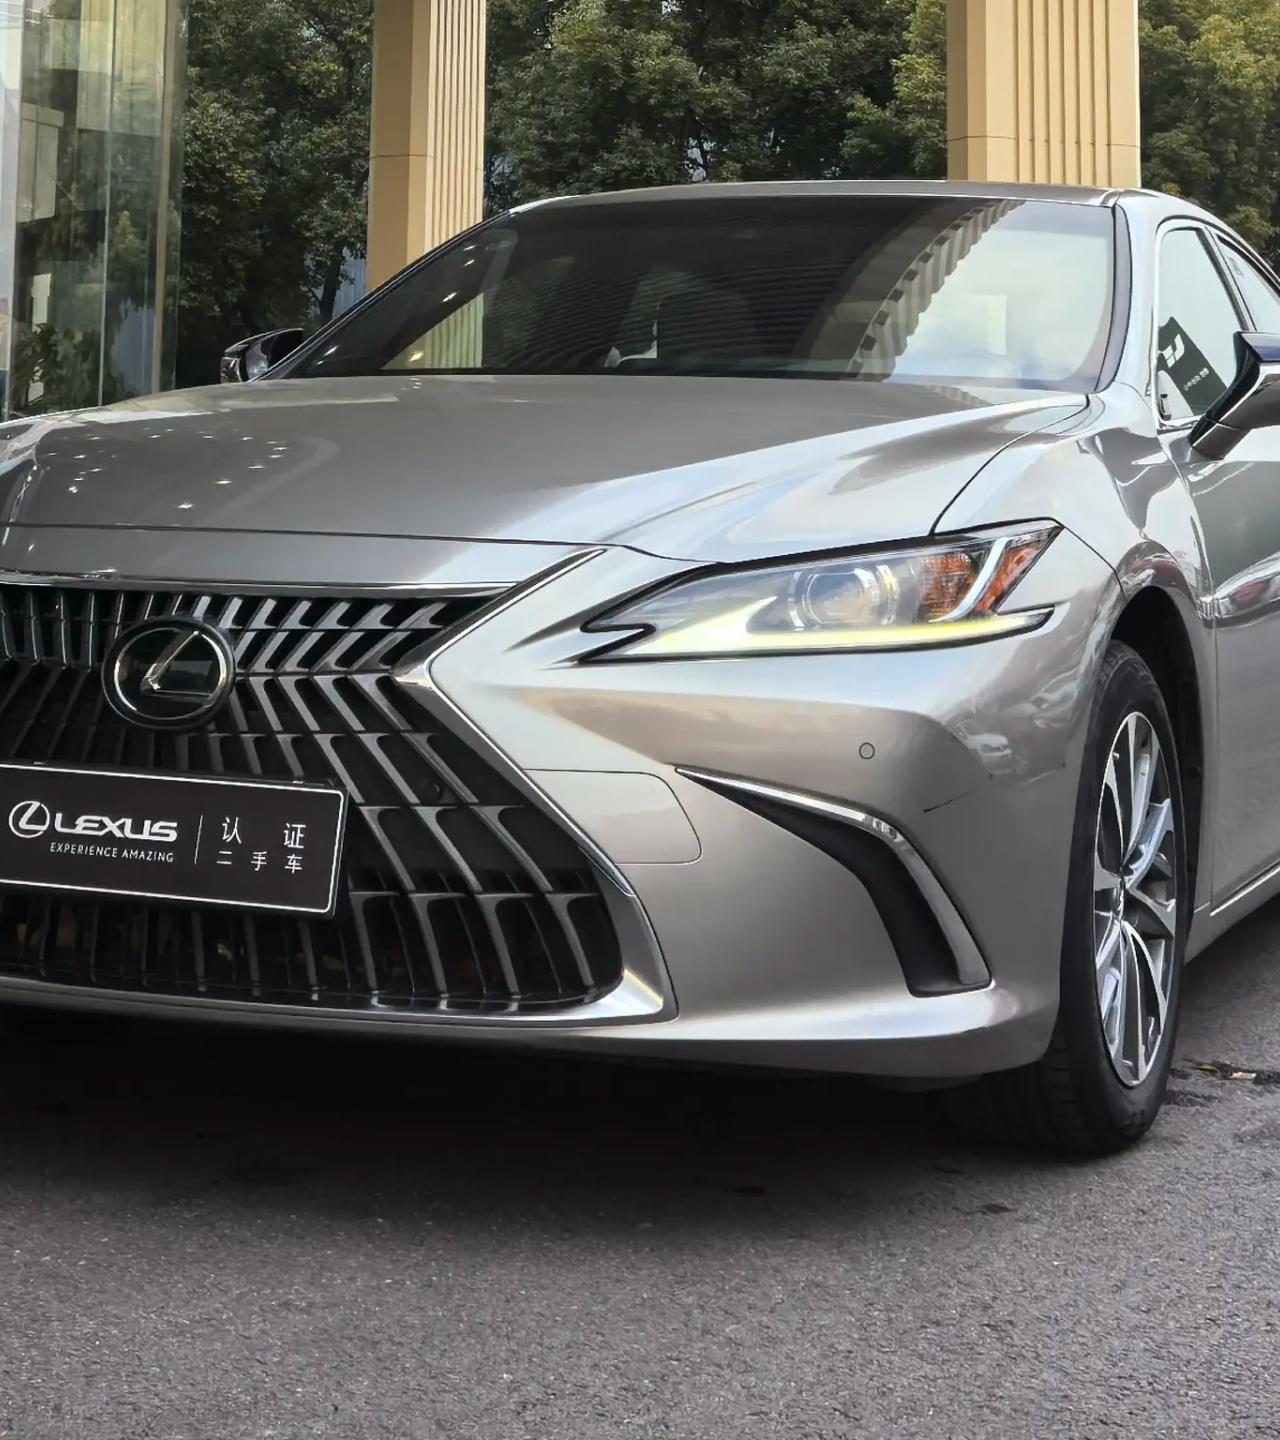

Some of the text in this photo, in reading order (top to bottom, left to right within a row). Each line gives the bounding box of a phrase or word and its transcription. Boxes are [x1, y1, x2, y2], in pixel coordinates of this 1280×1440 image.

[54, 812, 178, 842] LEXUS
[50, 841, 174, 863] EXPERIENCE AMAZING
[216, 850, 304, 875] 二手车
